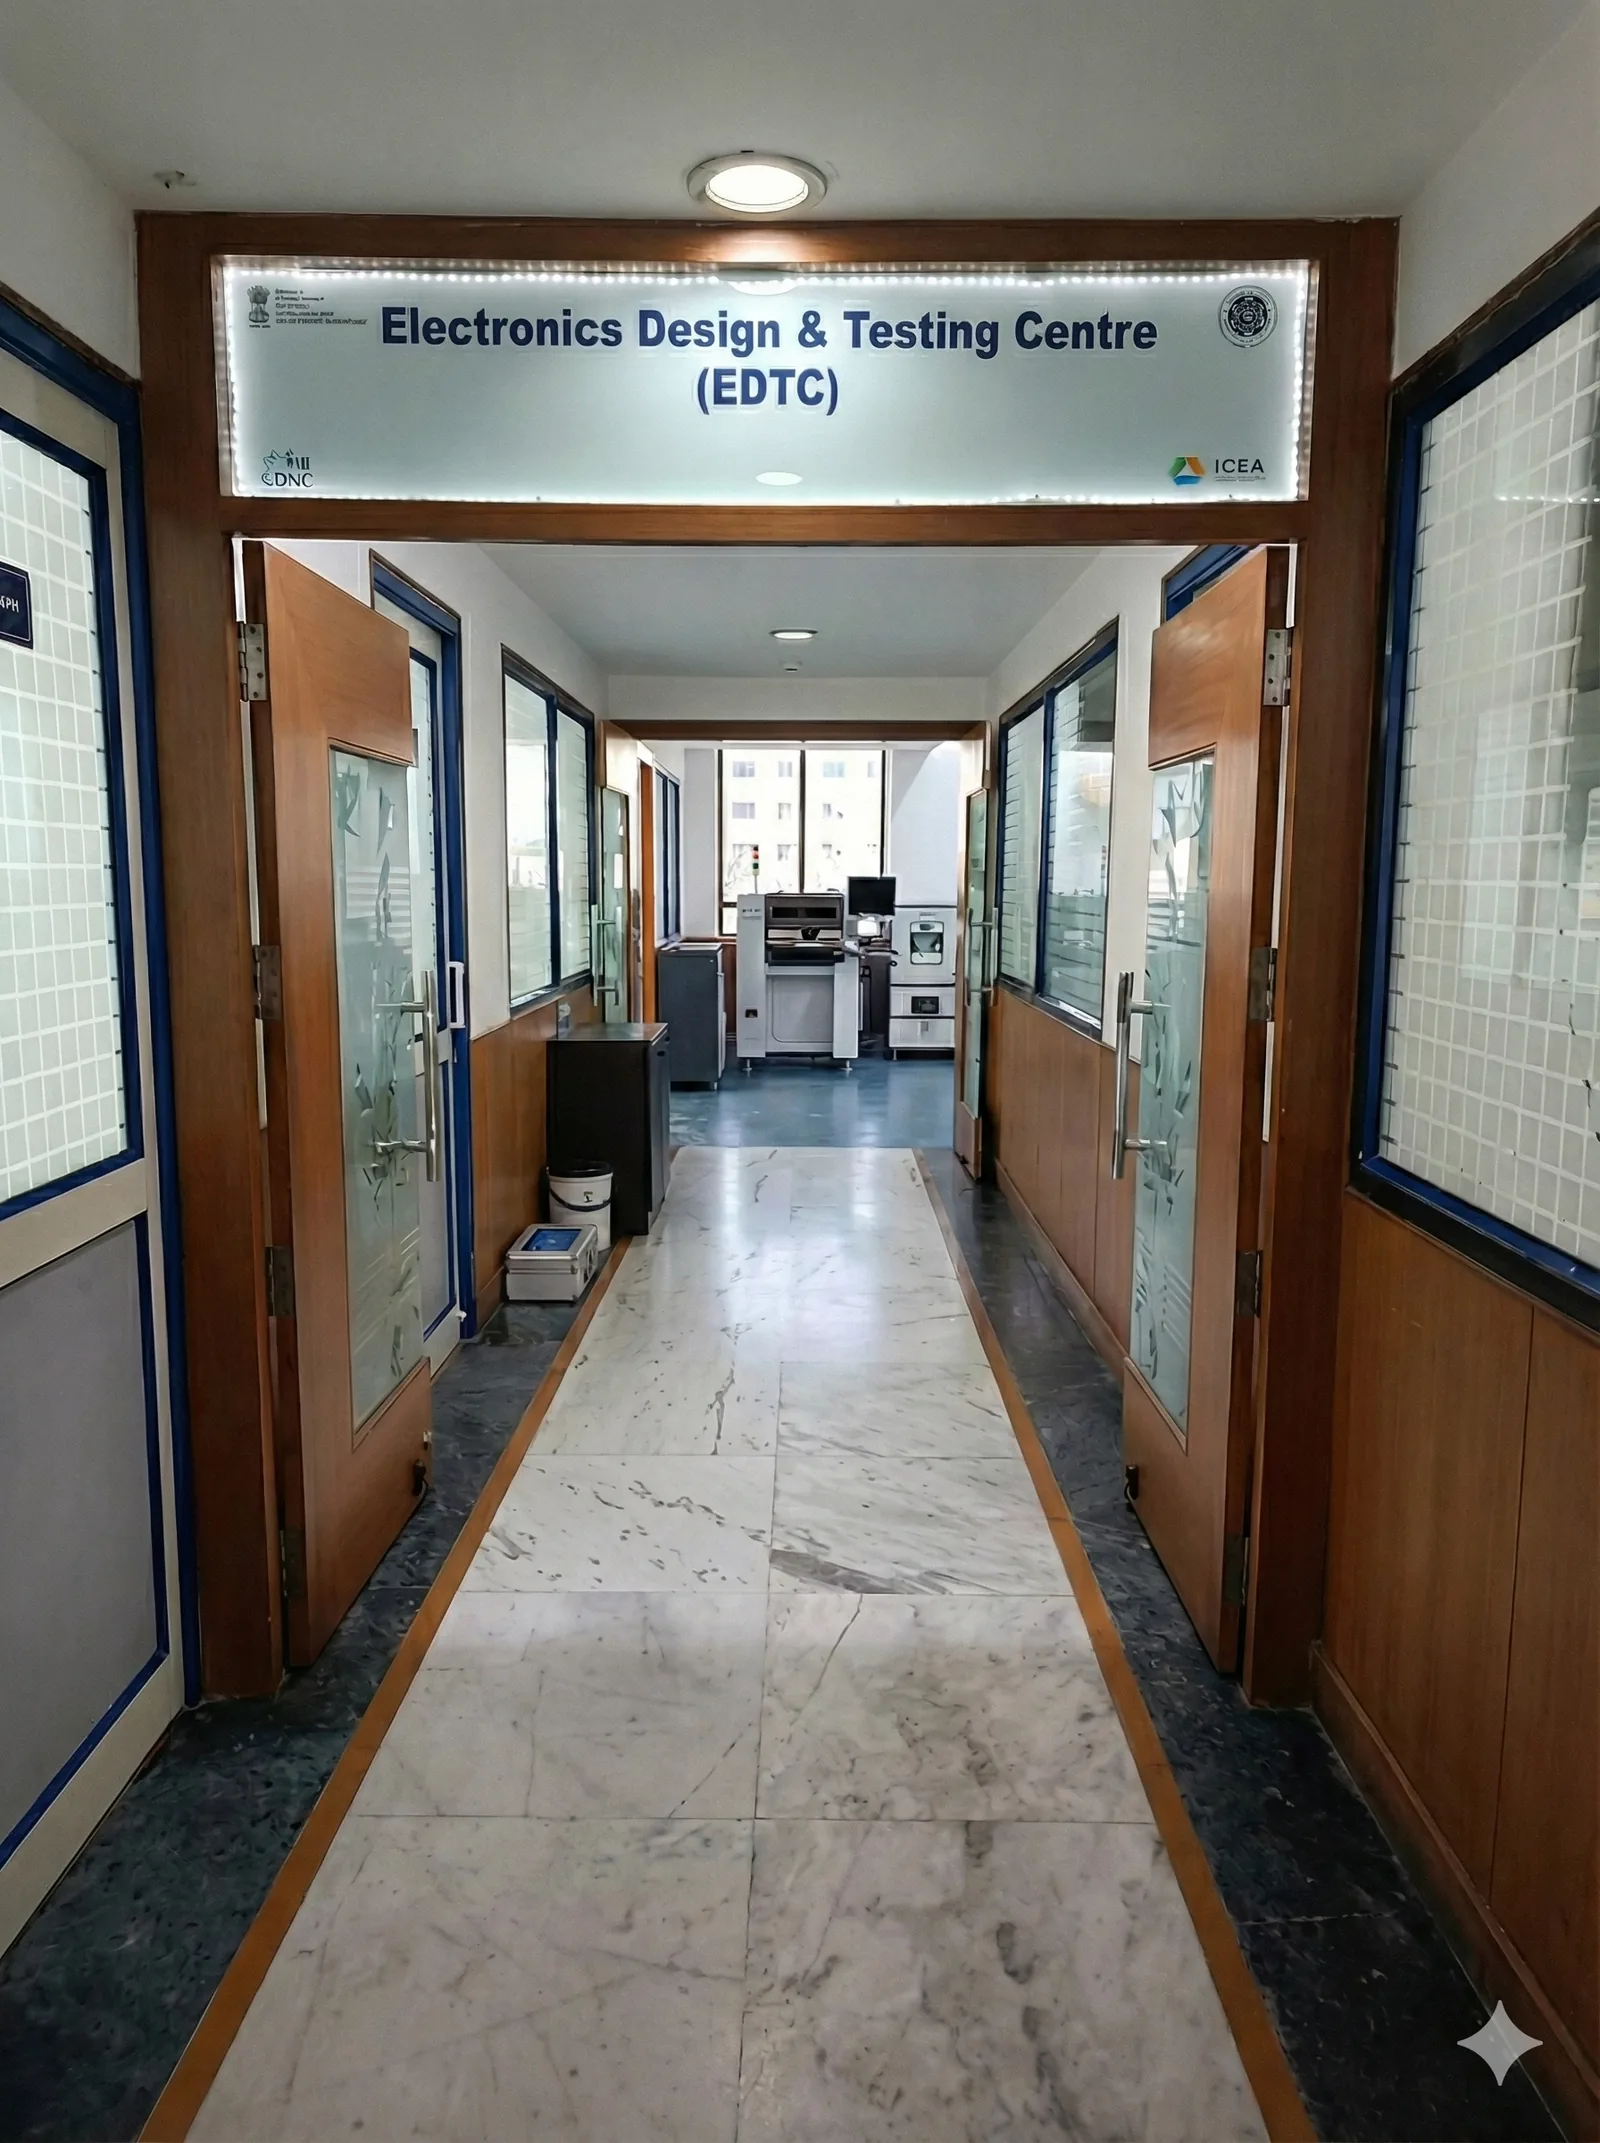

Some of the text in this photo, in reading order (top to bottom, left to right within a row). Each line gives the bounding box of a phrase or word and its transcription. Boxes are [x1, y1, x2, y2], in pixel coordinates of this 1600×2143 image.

[381, 306, 1158, 360] Electronics Design & Testing Centre
[697, 367, 838, 416] (EDTC)
[1215, 458, 1264, 473] ICEA
